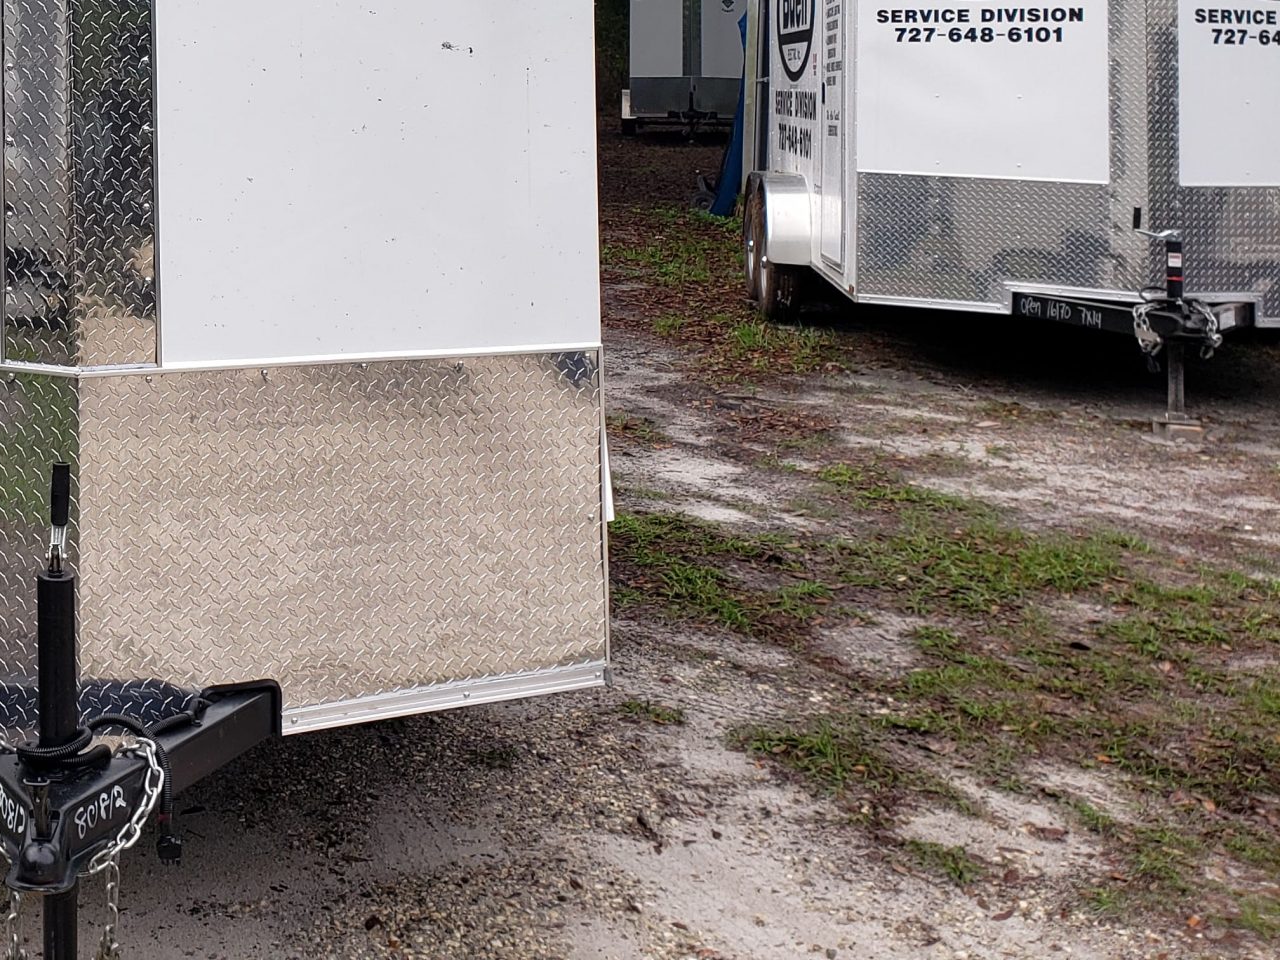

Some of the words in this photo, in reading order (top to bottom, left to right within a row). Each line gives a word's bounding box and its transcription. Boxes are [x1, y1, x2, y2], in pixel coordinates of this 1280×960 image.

[876, 8, 970, 24] SERVICE
[980, 7, 1084, 23] DIVISION
[1194, 8, 1277, 25] SERVICE
[894, 26, 1063, 43] 727-648-6101
[775, 90, 793, 117] SERVICE
[795, 91, 817, 121] DIVISION
[778, 122, 812, 160] 727-648-6101
